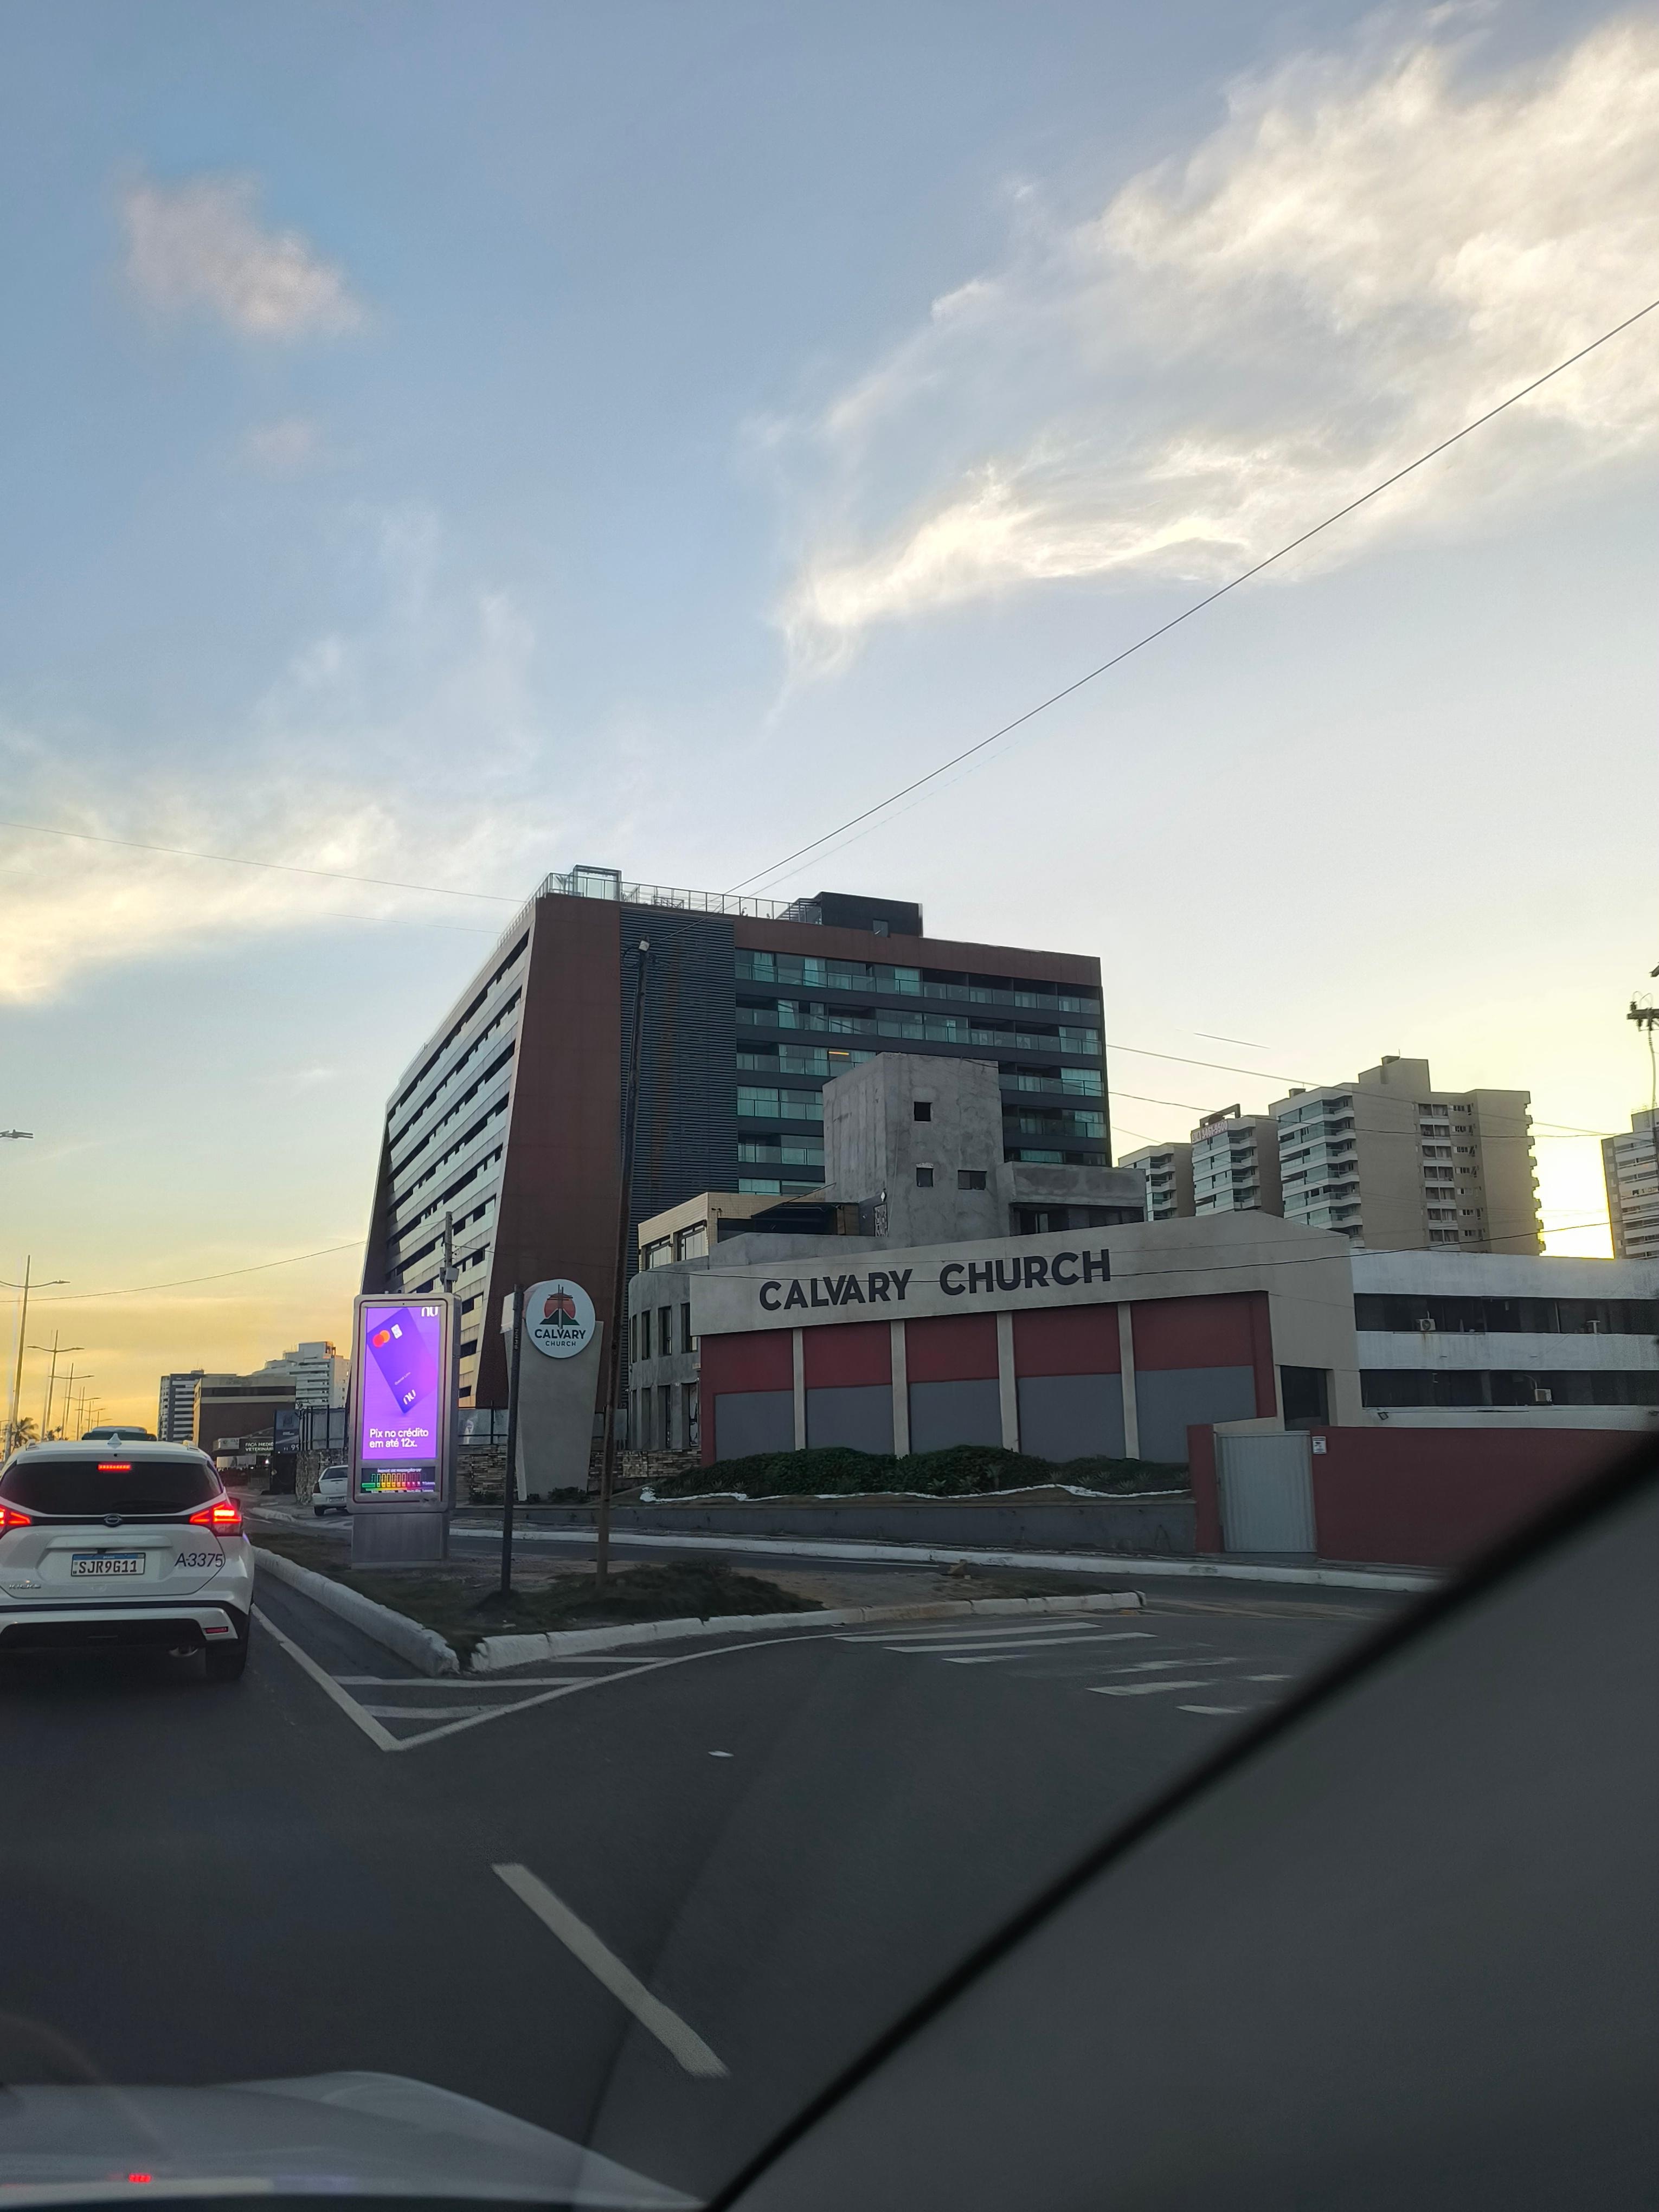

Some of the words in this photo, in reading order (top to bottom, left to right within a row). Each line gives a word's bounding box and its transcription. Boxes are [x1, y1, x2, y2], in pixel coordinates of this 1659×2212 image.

[759, 1269, 913, 1311] CALVARY
[940, 1249, 1110, 1295] CHURCH
[535, 1329, 586, 1339] CALVARY
[370, 1429, 383, 1438] Pix
[398, 1427, 429, 1437] crédito
[385, 1438, 399, 1448] até
[401, 1438, 417, 1447] 12x.
[174, 1553, 223, 1567] A-3375
[79, 1560, 137, 1573] SJR9G11
